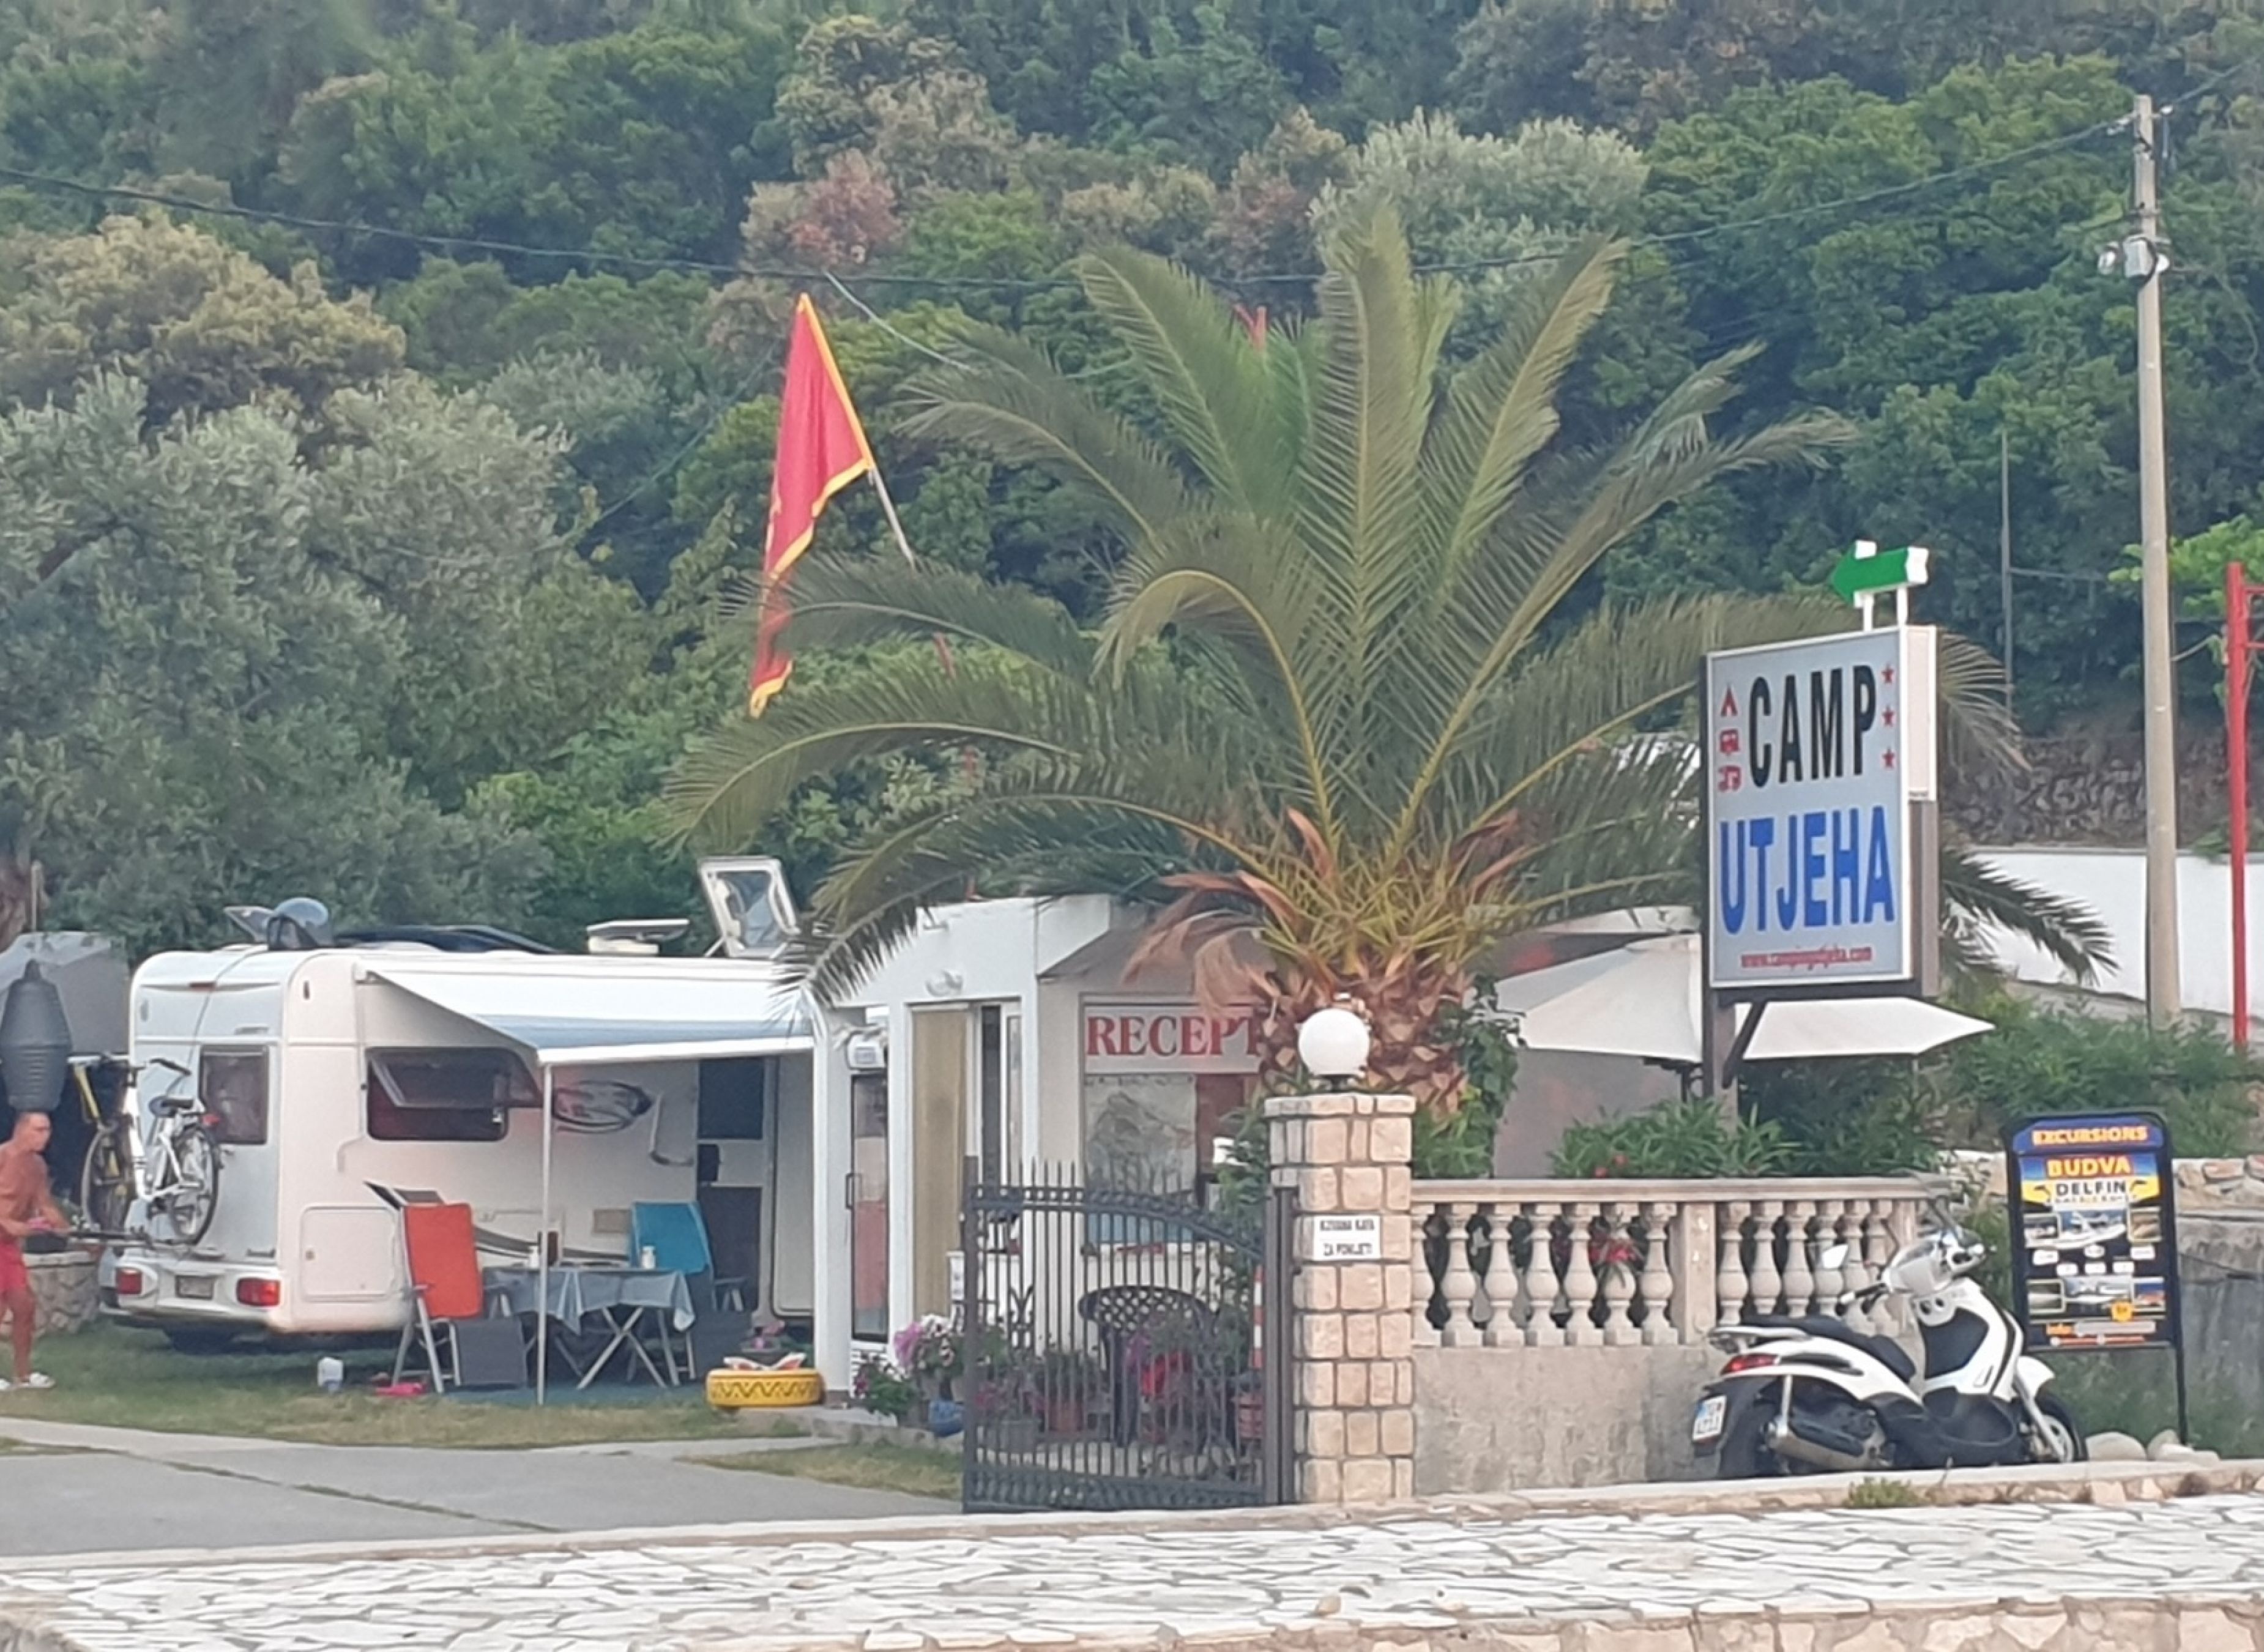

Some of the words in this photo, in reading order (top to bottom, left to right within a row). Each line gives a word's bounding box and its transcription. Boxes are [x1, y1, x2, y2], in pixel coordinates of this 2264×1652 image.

[1749, 664, 1876, 788] CAMP
[1720, 806, 1895, 935] UTJEHA
[2032, 1126, 2147, 1145] EXCURSIONS
[2047, 1156, 2131, 1176] BUDVA
[2056, 1180, 2126, 1196] DELFIN
